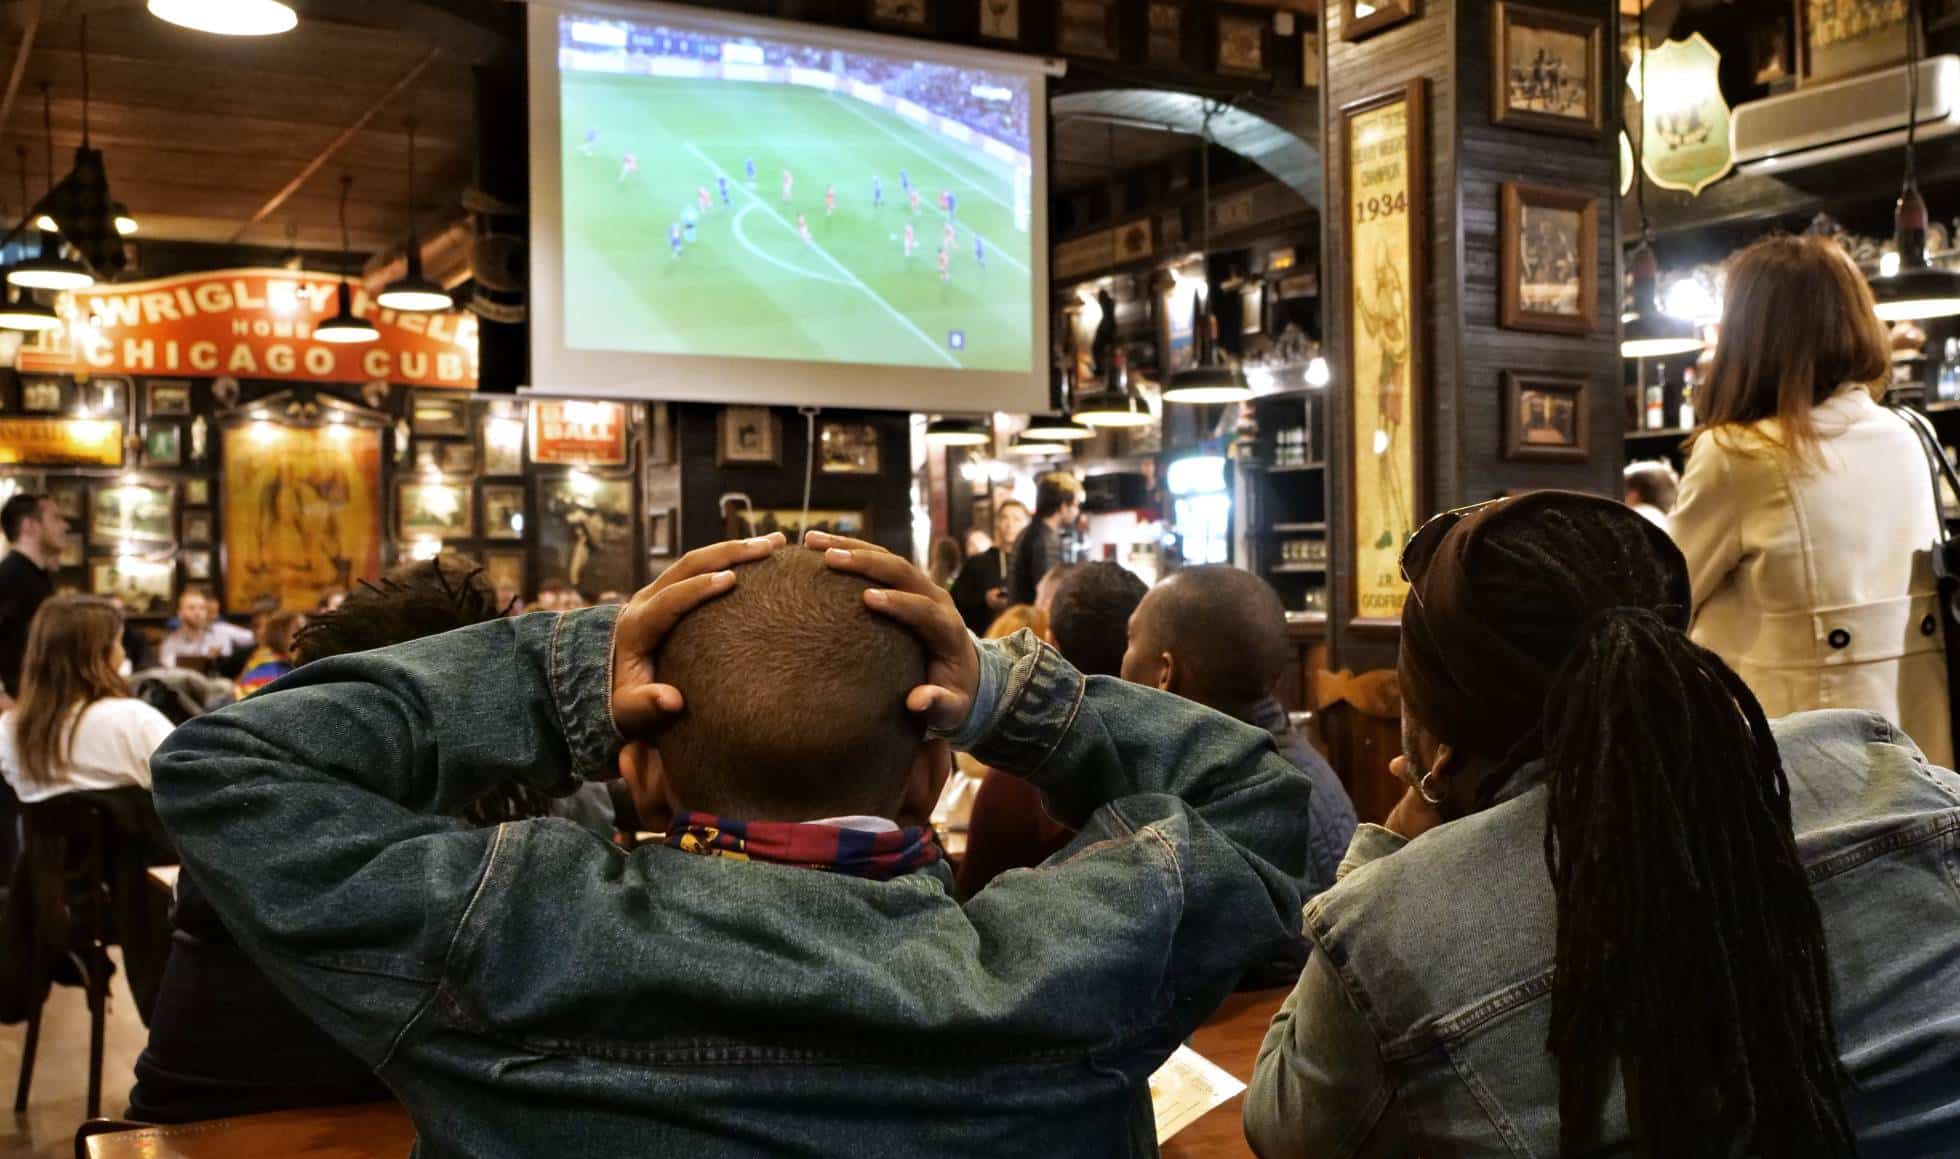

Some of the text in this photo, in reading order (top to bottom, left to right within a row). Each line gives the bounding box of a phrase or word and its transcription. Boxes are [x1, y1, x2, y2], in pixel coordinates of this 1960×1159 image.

[1356, 190, 1408, 224] 1934
[89, 278, 337, 328] WRIGLEY
[232, 319, 311, 339] HOME
[85, 338, 335, 375] CHICAGO
